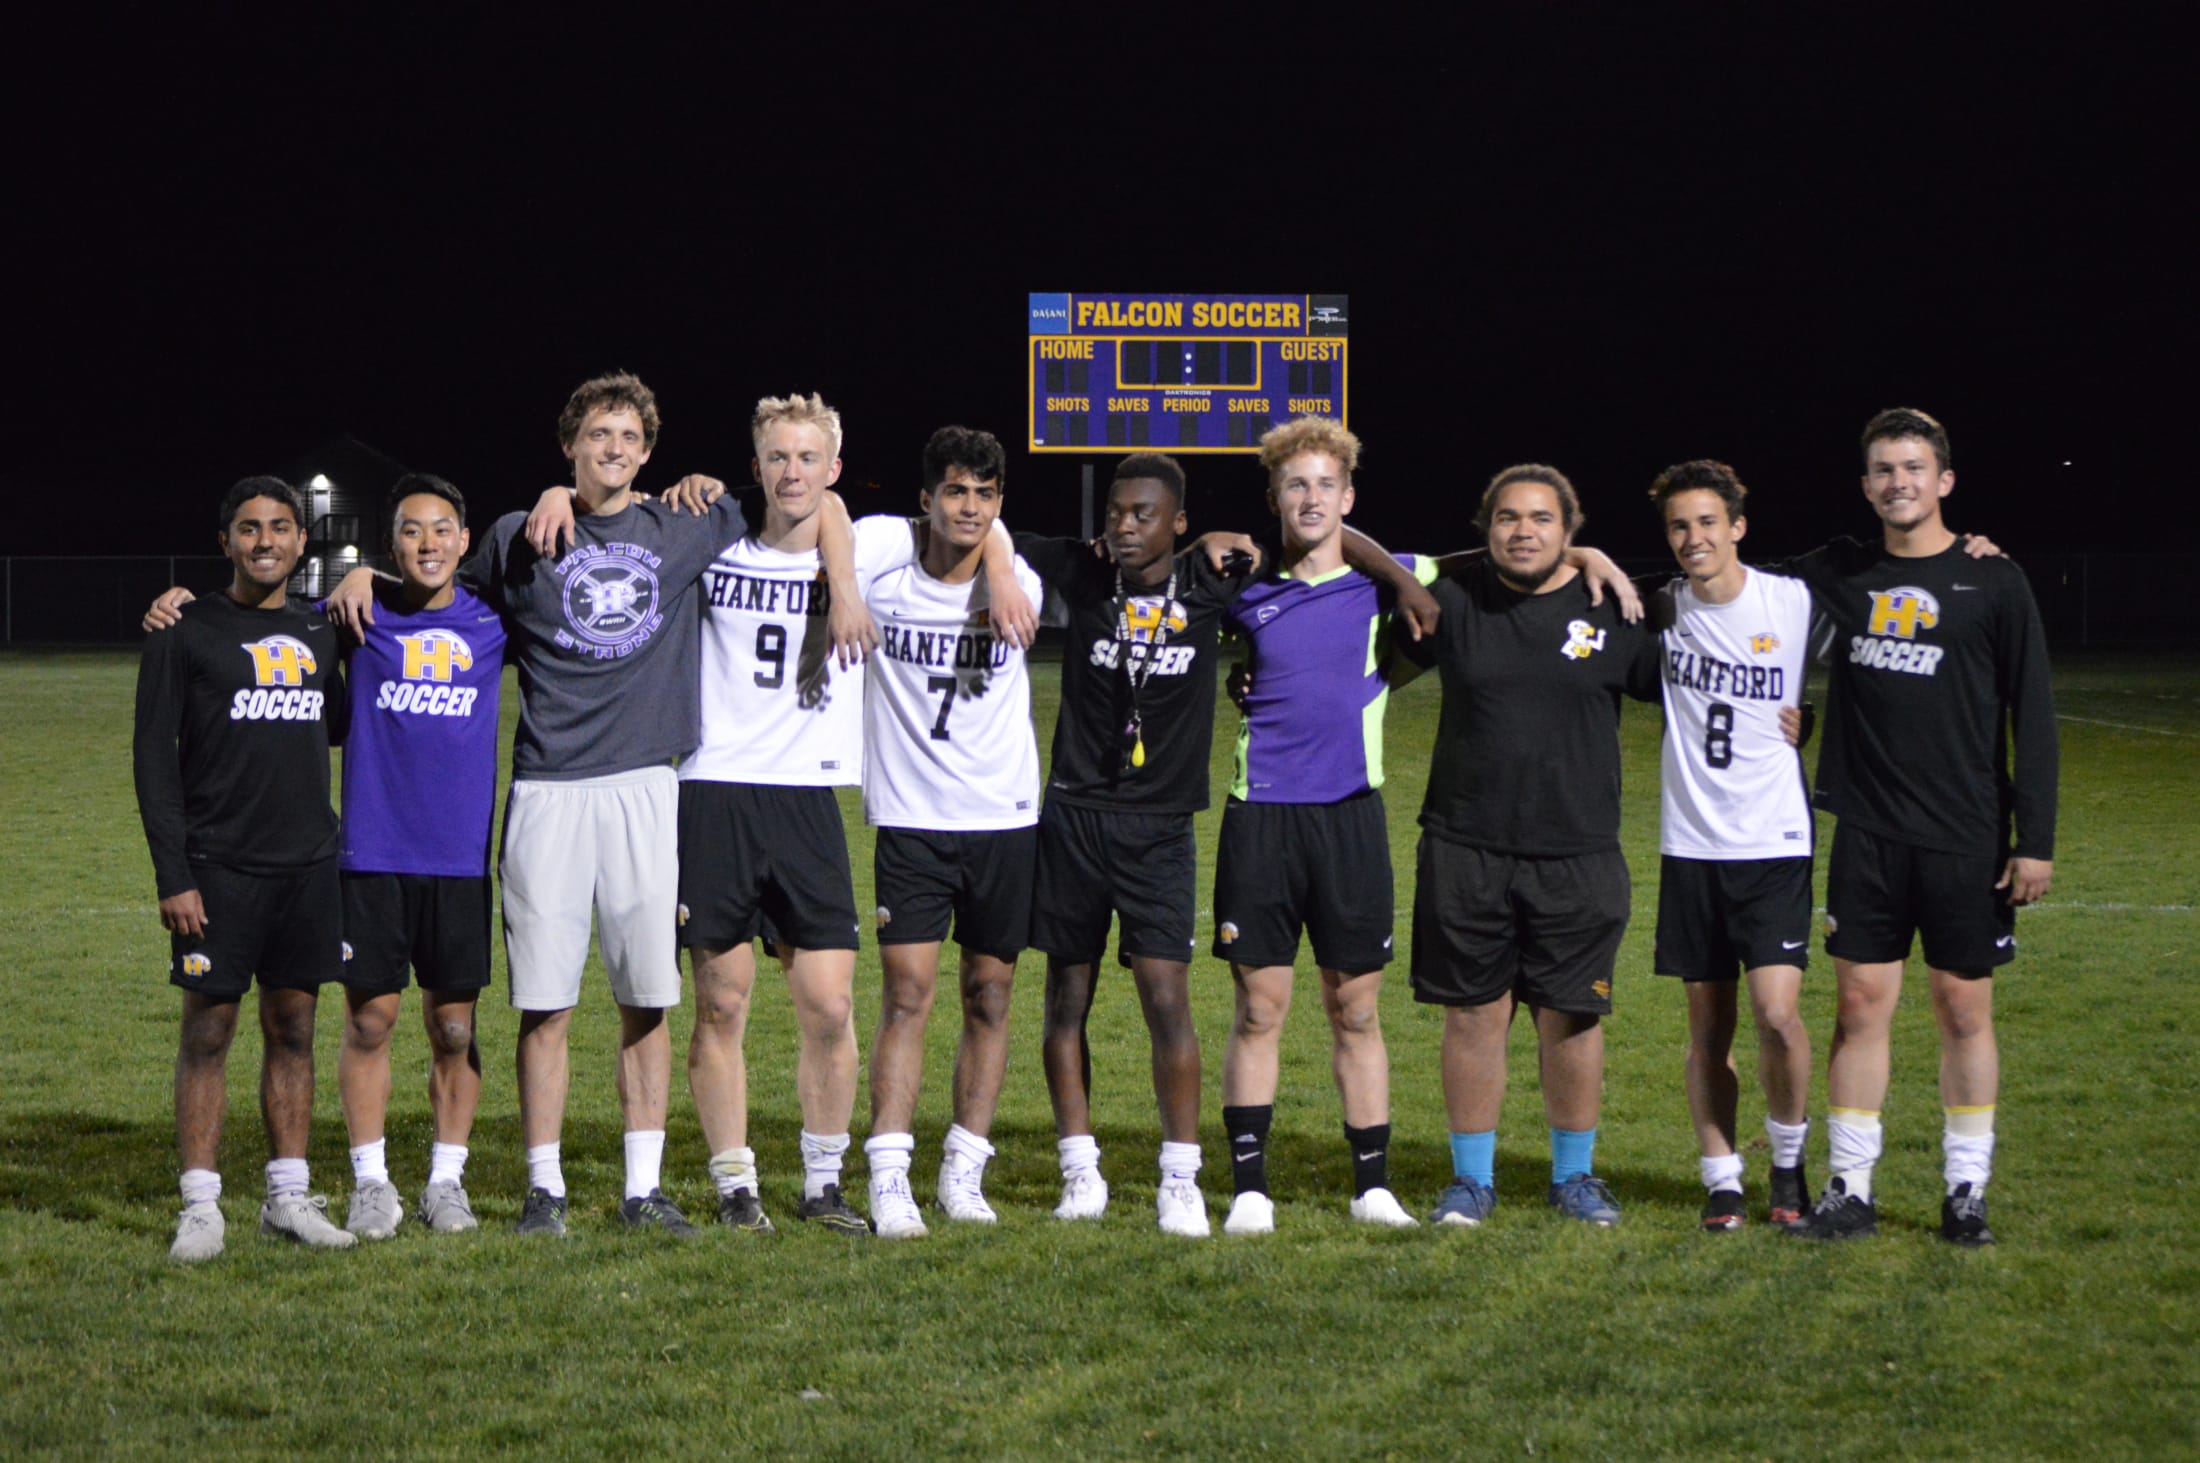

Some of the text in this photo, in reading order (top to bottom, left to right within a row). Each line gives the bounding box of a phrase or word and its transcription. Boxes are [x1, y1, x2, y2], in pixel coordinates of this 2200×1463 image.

[1032, 309, 1066, 319] DASANI
[1077, 301, 1300, 328] FALCON SOCCER
[1040, 340, 1094, 359] HOME
[1280, 341, 1341, 361] GUEST
[1047, 398, 1090, 412] SHOTS
[1107, 398, 1150, 412] SAVES
[1163, 398, 1211, 412] PERIOD
[1228, 398, 1270, 413] SAVES
[1288, 399, 1331, 413] SHOTS
[555, 542, 662, 575] FALCON
[709, 572, 830, 617] HANFOR
[553, 613, 664, 659] STRONG
[883, 625, 1009, 670] HANFORD
[754, 623, 787, 690] 9
[1849, 635, 1944, 676] SOCCER
[1671, 650, 1783, 700] HANFORD
[230, 688, 324, 720] SOCCER
[376, 680, 478, 717] SOCCER
[927, 676, 957, 741] 7
[1705, 703, 1734, 770] 8
